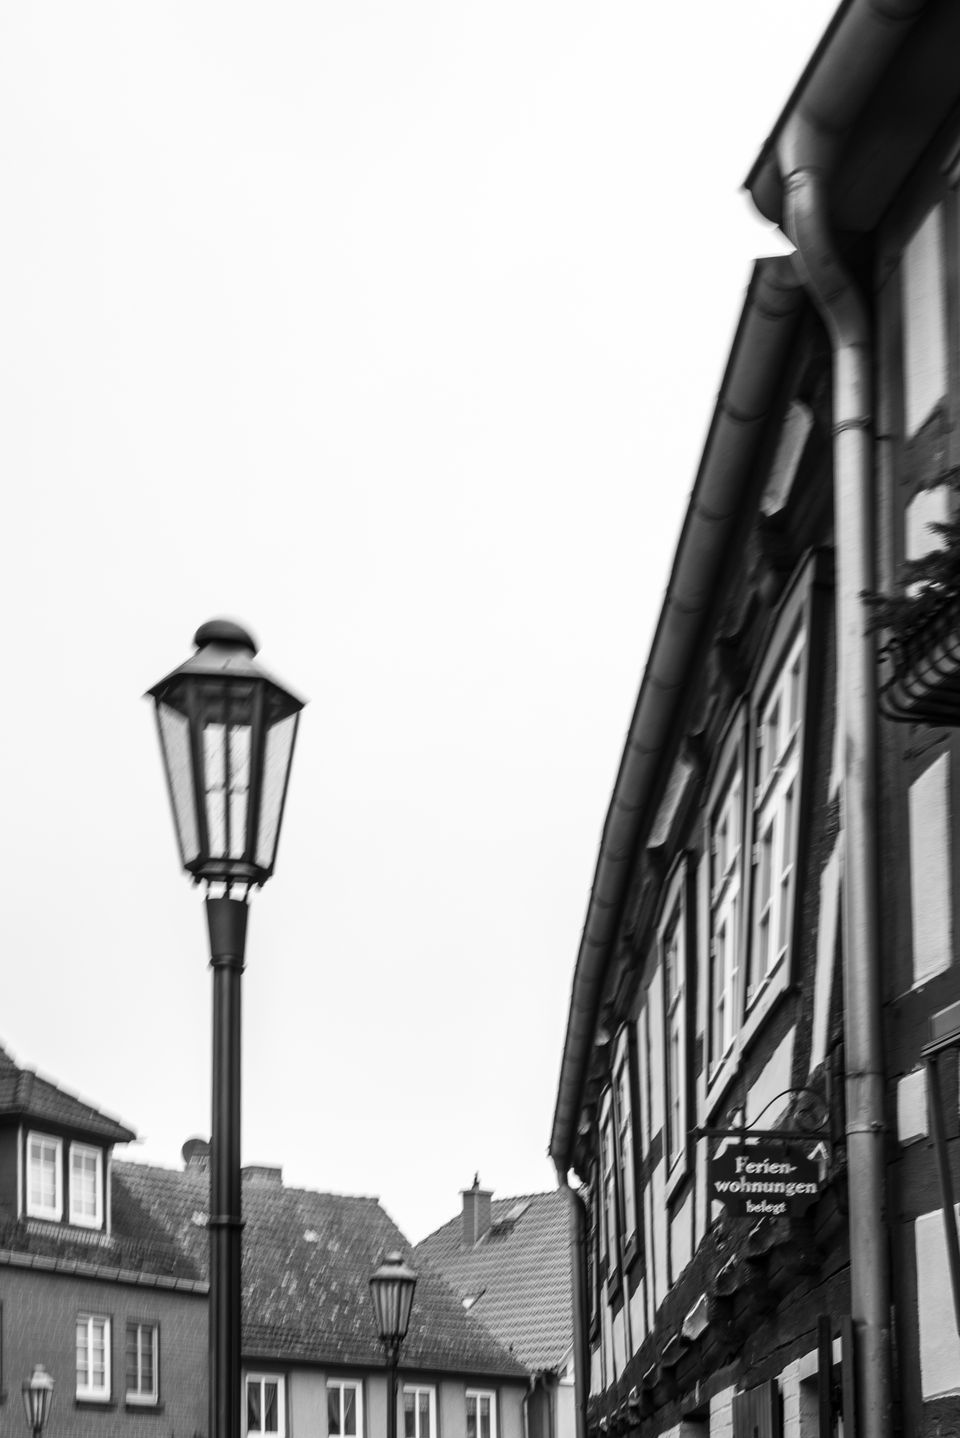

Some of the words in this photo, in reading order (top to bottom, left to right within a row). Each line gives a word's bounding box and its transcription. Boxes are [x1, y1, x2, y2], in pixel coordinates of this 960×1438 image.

[735, 1156, 798, 1174] Ferien-
[714, 1176, 818, 1197] wohnungen
[745, 1199, 787, 1215] belegt
